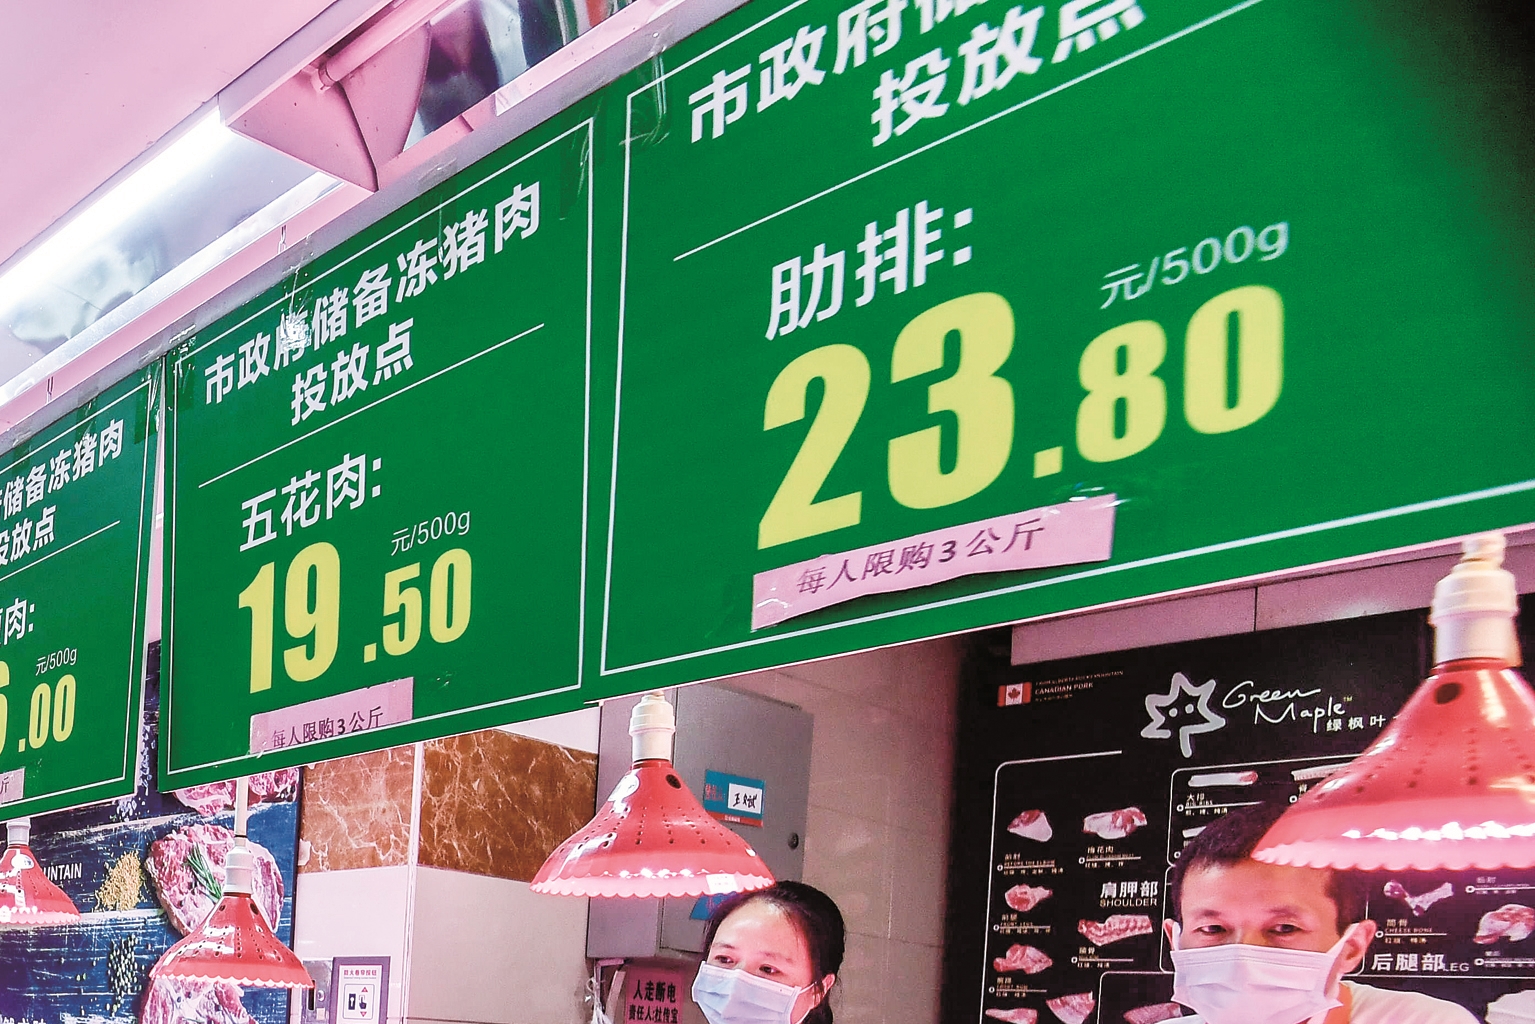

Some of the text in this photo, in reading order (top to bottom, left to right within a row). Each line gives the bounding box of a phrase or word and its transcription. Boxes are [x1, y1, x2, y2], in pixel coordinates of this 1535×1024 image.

[870, 0, 1149, 148] 投放点
[764, 199, 975, 341] 肋排:
[1099, 221, 1291, 310] 元/500g
[202, 180, 543, 405] 市政府储备冻猪肉
[289, 317, 415, 425] 投放点
[755, 284, 1287, 551] 23.80
[239, 452, 383, 553] 五花肉:
[390, 508, 472, 558] 元/500g
[795, 519, 1046, 598] 每人限购3公斤
[236, 540, 474, 694] 19.50
[34, 647, 78, 676] 元/500g
[1222, 680, 1322, 709] Green
[1254, 697, 1347, 734] Maple
[270, 705, 385, 749] 每人限购3公斤
[43, 862, 82, 882] UNTAIN
[1100, 880, 1159, 900] 肩胛部
[1099, 897, 1159, 908] SHOULDER
[1371, 952, 1445, 973] 后腿部
[632, 979, 676, 1003] 人走断电
